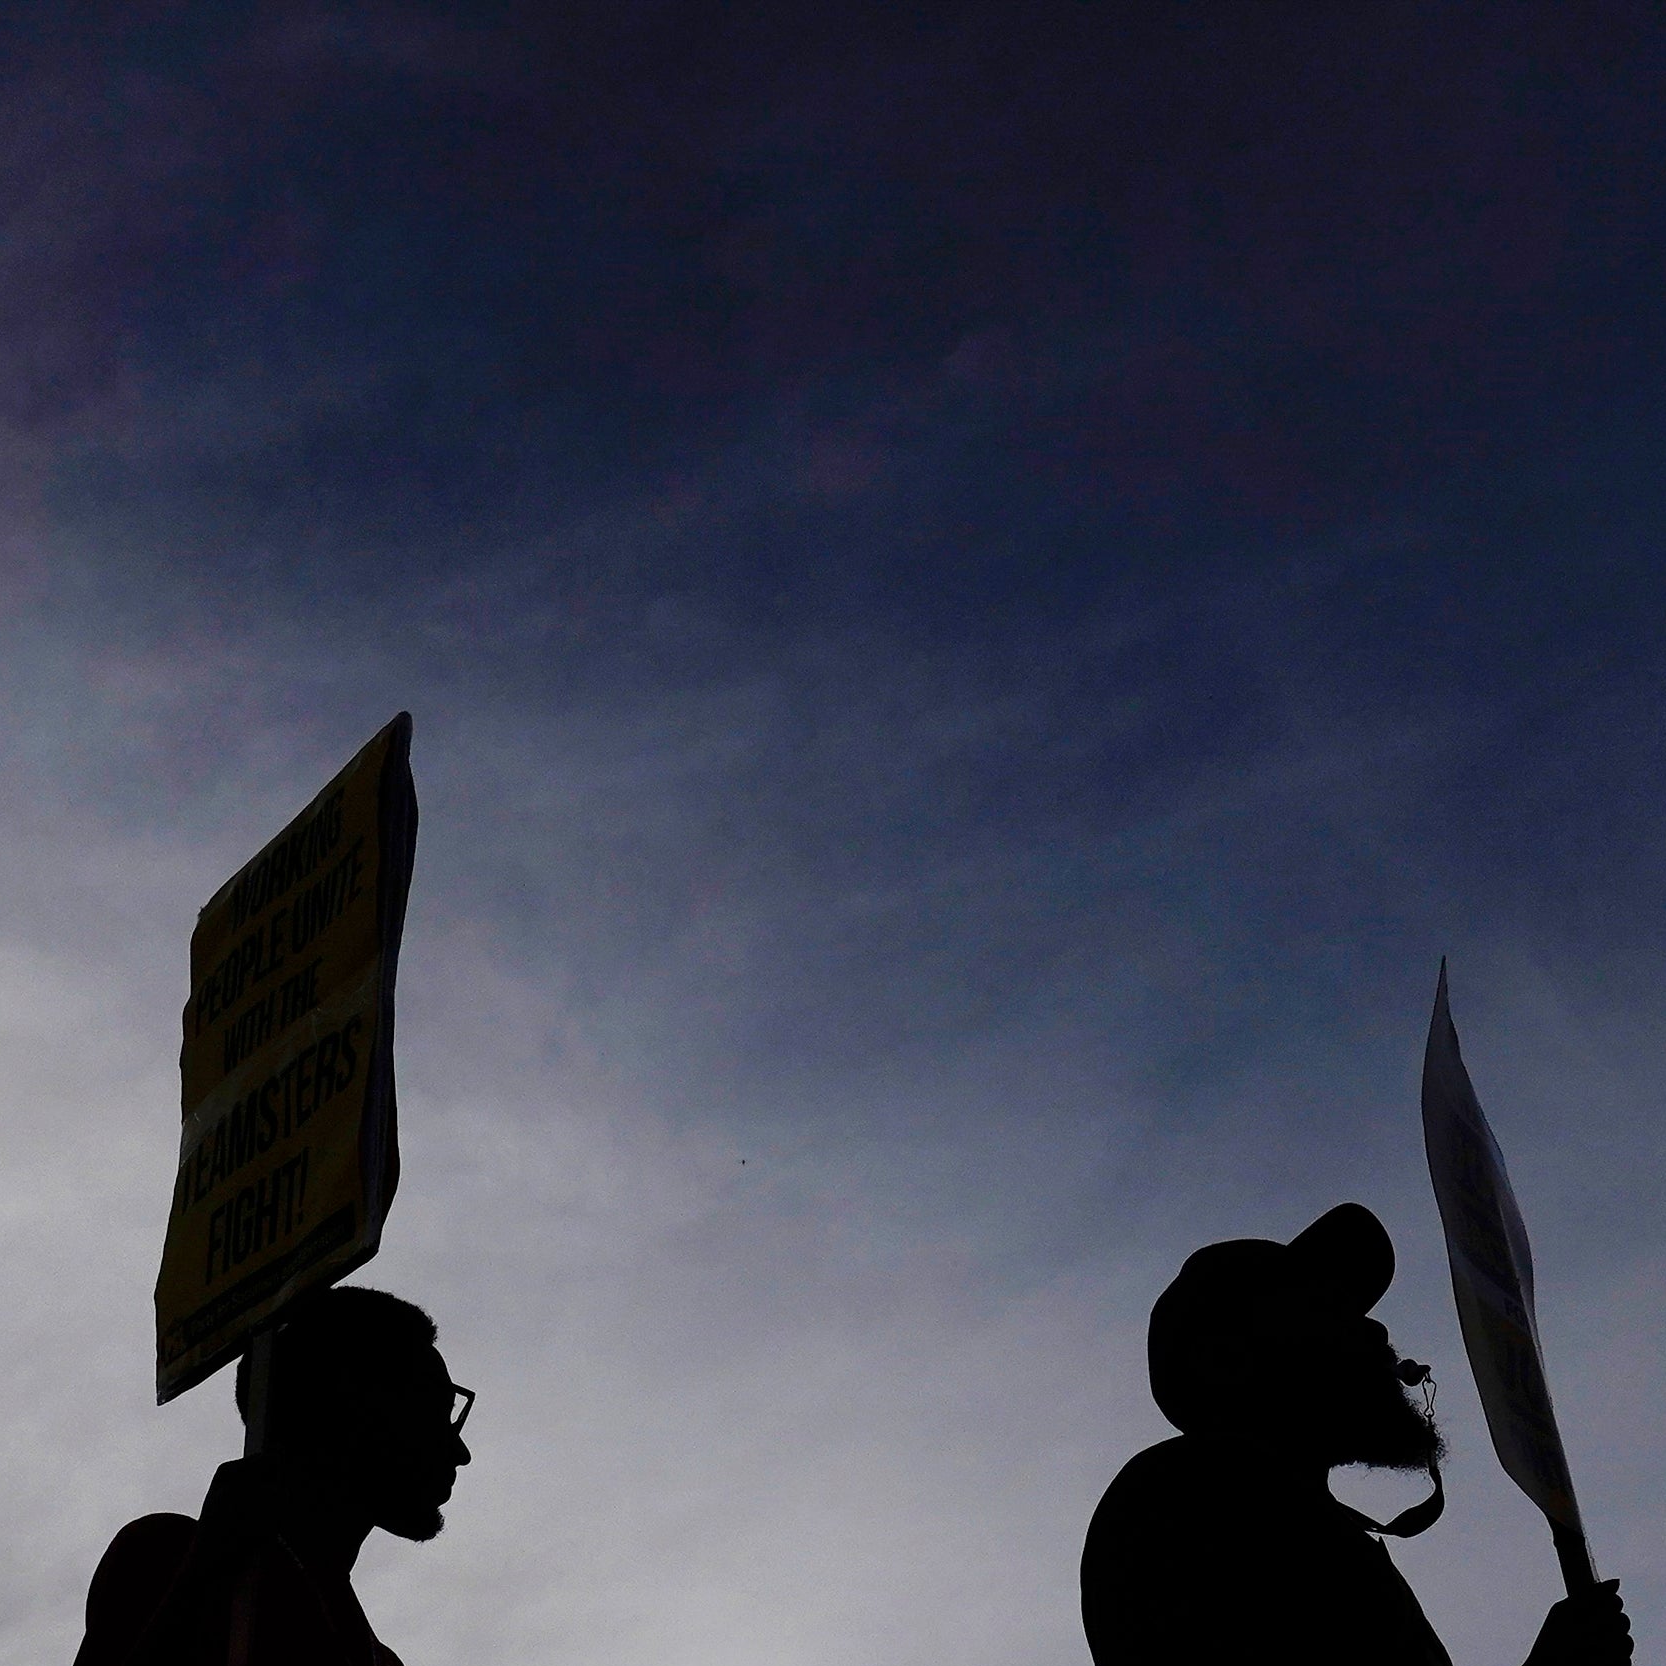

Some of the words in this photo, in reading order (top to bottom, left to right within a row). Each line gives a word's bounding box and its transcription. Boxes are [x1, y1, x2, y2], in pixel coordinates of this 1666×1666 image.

[230, 785, 346, 930] WORKING
[193, 900, 285, 1036] PEOPLE
[289, 834, 364, 960] UNITE
[223, 996, 276, 1078] WITH
[279, 956, 324, 1032] THE
[180, 1014, 364, 1216] TEAMSTERS
[206, 1145, 310, 1286] FIGHT!
